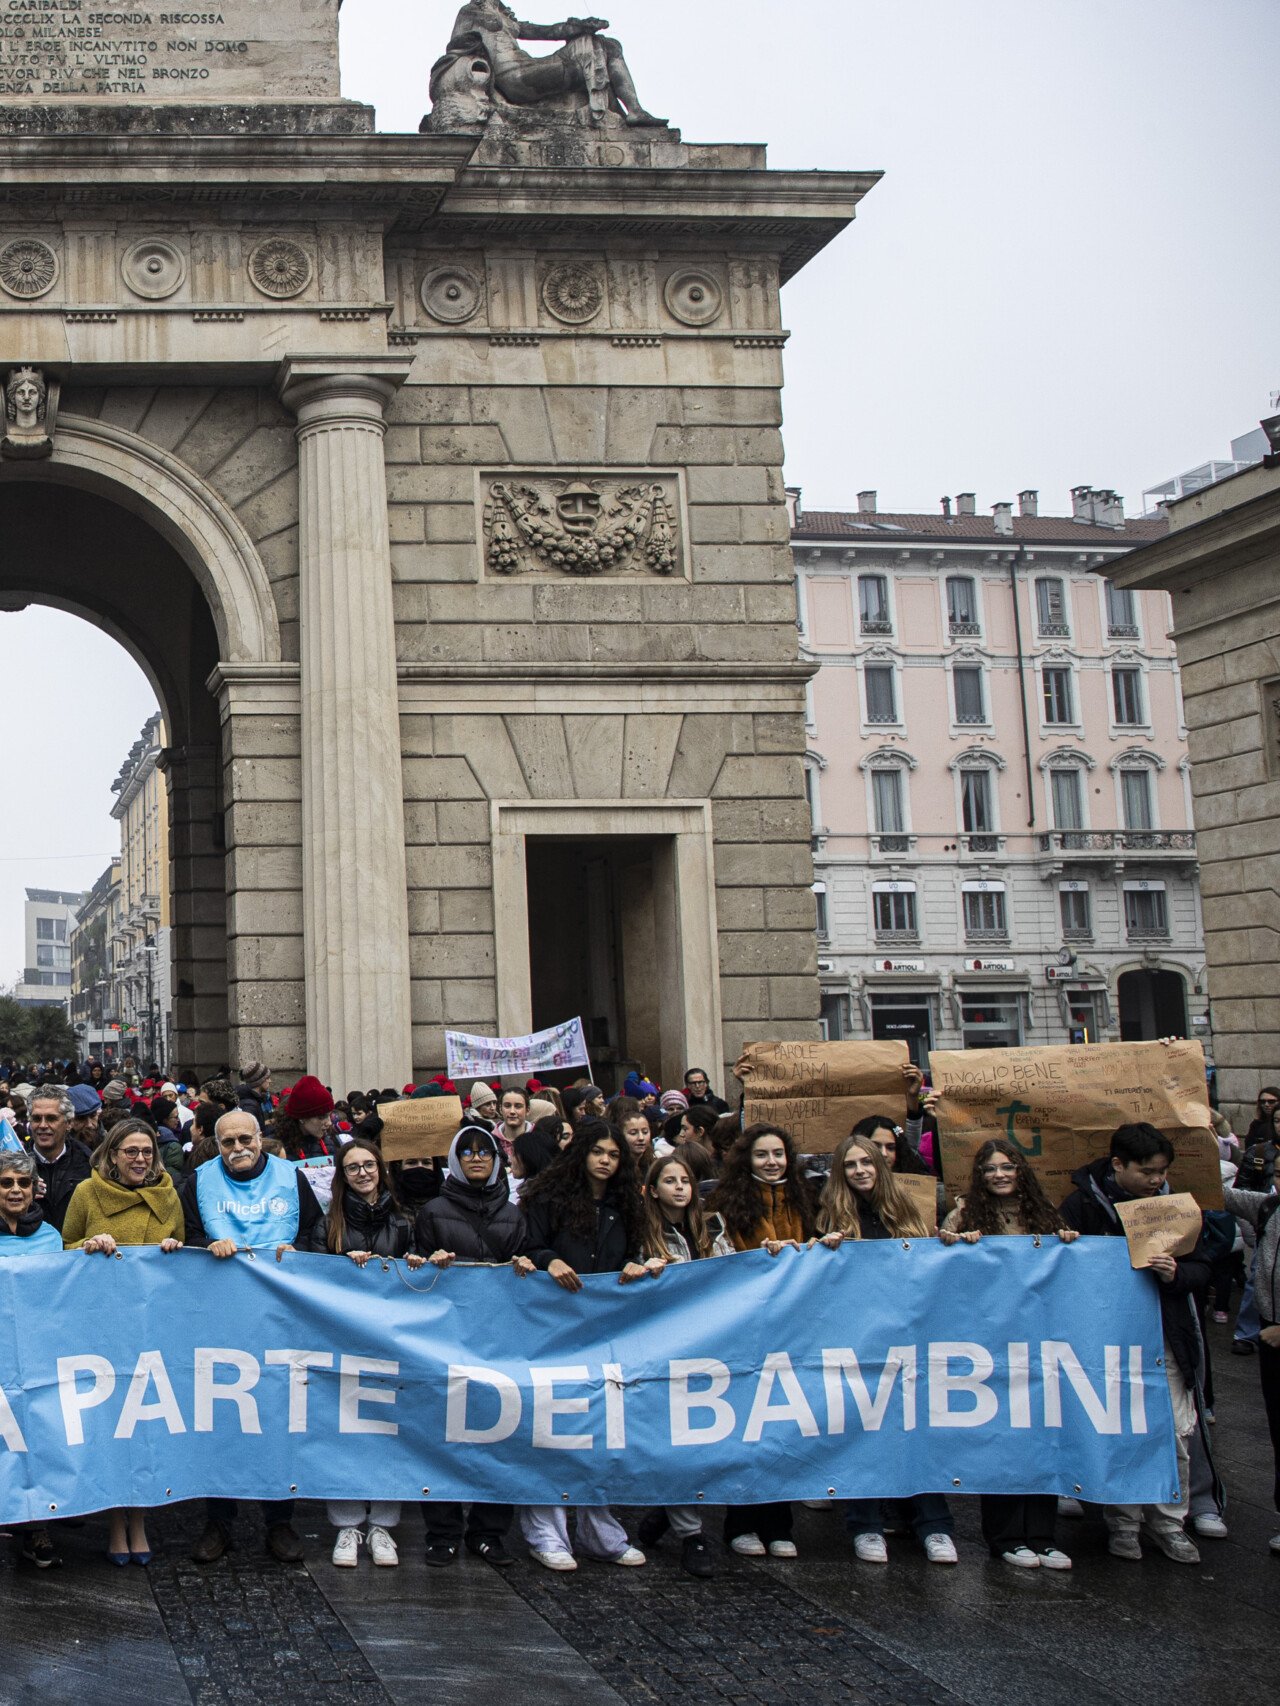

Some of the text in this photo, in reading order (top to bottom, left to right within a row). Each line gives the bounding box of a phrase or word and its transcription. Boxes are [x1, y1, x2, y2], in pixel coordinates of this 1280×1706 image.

[9, 0, 82, 11] GARIBALDI
[62, 14, 81, 24] LA
[88, 14, 152, 24] SECONDA
[160, 14, 225, 24] RISCOSSA
[32, 27, 102, 38] MILANESE
[26, 41, 61, 51] EROE
[69, 41, 158, 51] INCANVTITO
[167, 41, 197, 51] NON
[205, 41, 248, 52] DOMO
[47, 55, 67, 66] FV
[95, 55, 147, 65] VLTIMO
[82, 69, 110, 79] CHE
[118, 69, 146, 79] NEL
[152, 69, 209, 79] BRONZO
[43, 83, 88, 93] DELLA
[96, 83, 146, 93] PATRIA
[774, 1044, 819, 1060] PAROLE
[749, 1062, 829, 1082] SONO ARMI
[942, 1061, 1062, 1084] TI VOGLIO BENE
[751, 1083, 857, 1099] SANNO FARE MALE
[984, 1083, 1010, 1096] CHE
[750, 1101, 831, 1122] DEVI SAPERLE
[217, 1197, 266, 1216] unicef
[57, 1347, 400, 1446] PARTE
[445, 1363, 626, 1449] DEI
[669, 1341, 1148, 1446] BAMBINI
